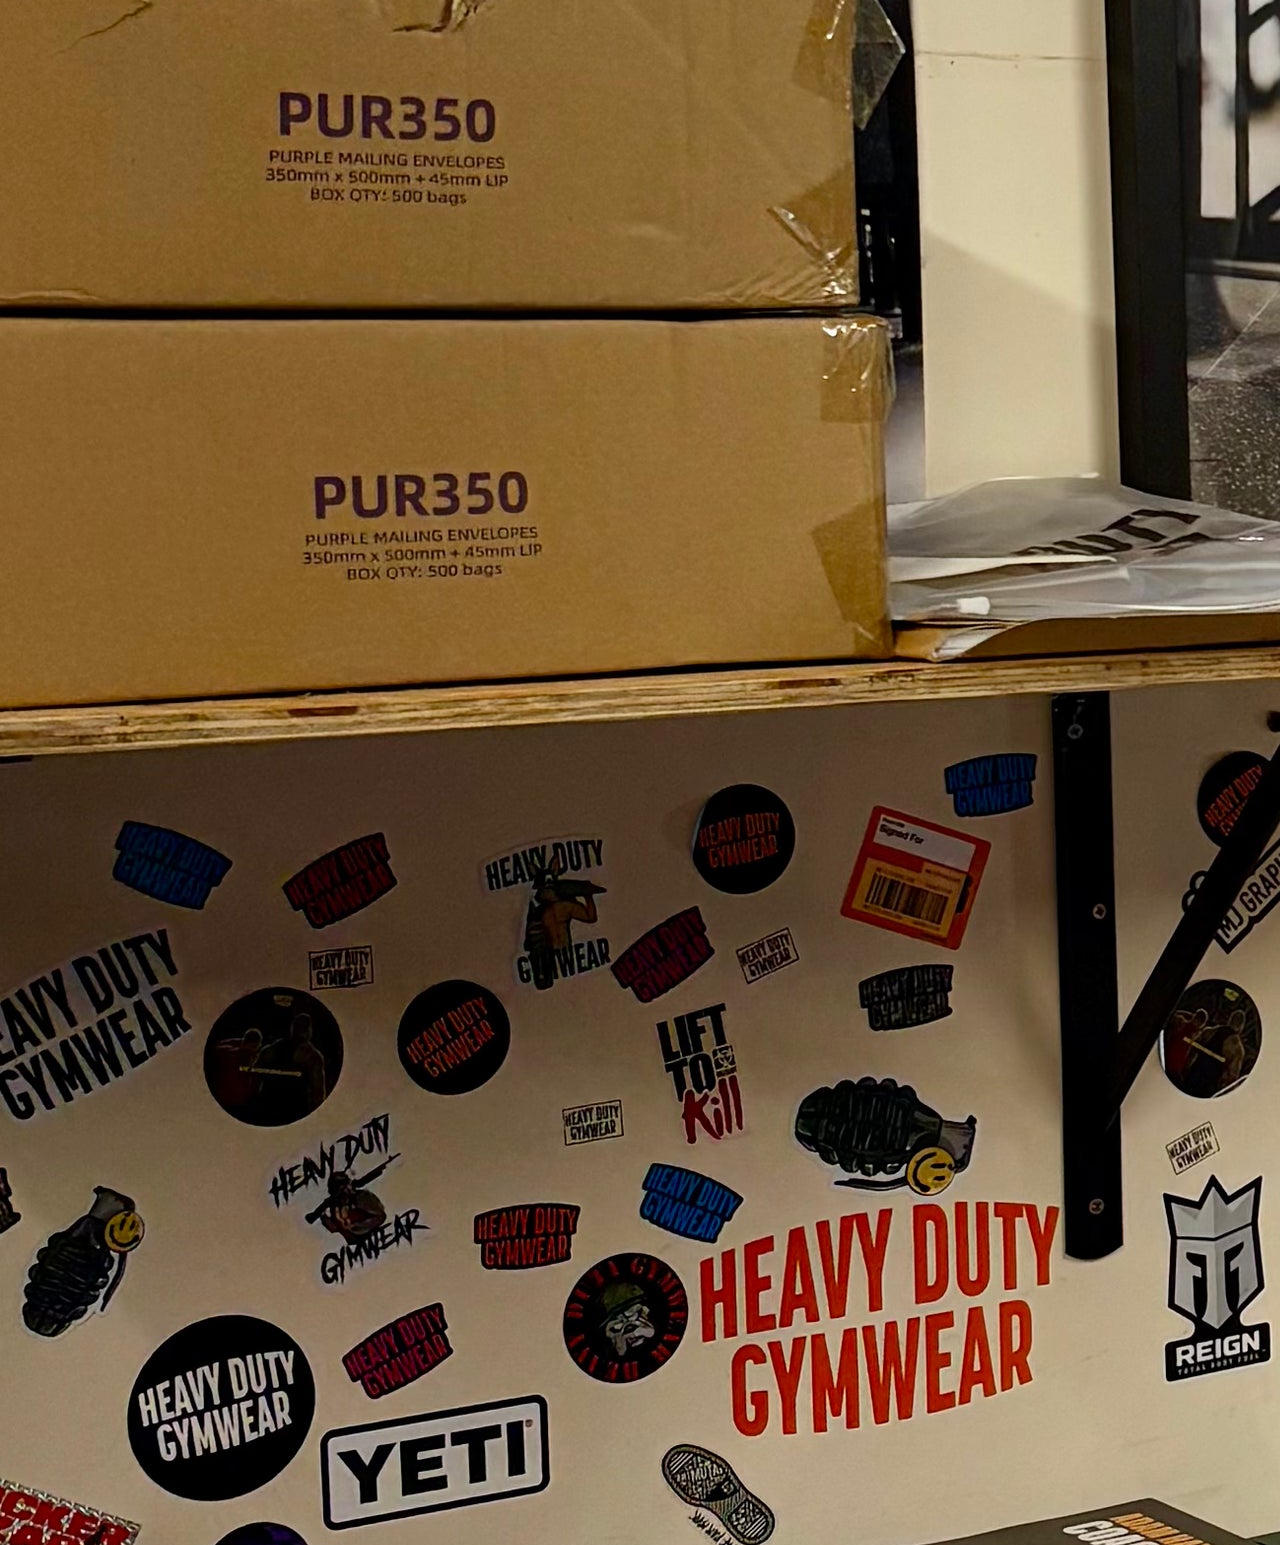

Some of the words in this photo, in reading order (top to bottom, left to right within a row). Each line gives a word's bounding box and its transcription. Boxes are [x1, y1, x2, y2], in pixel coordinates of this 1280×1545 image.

[279, 92, 496, 143] PUR350
[266, 168, 330, 182] 350mm
[348, 170, 411, 184] 500mm
[428, 173, 481, 187] 45mm
[269, 150, 333, 165] PURPLE
[338, 152, 408, 167] MAILING
[413, 154, 505, 169] ENVELOPES
[310, 187, 345, 201] BOX
[392, 189, 423, 203] 500
[427, 190, 468, 207] bags
[313, 471, 529, 519] PUR350
[303, 550, 365, 565] 350mm
[385, 548, 446, 562] 500mm
[465, 544, 516, 558] 45mm
[520, 543, 543, 556] LIP
[305, 532, 368, 547] PURPLE
[374, 530, 443, 544] MAILING
[448, 526, 538, 541] ENVELOPES
[347, 567, 381, 581] BOX
[386, 566, 423, 580] QTY:
[428, 564, 458, 577] 500
[462, 562, 503, 577] bags
[1204, 786, 1240, 829] HEAVY
[1238, 763, 1264, 798] DUTY
[699, 818, 741, 850] HEAVY
[743, 811, 781, 837] DUTY
[706, 833, 779, 869] GYMWEAR
[485, 847, 549, 891] HEAVY
[552, 839, 603, 876] DUTY
[1219, 910, 1246, 940] MJ
[516, 938, 612, 985] GWEAR
[0, 968, 79, 1066] AVY
[71, 928, 178, 1016] DUTY
[0, 986, 192, 1120] GYMWEAR
[405, 1014, 447, 1065] HEAVY
[446, 996, 490, 1037] DUTY
[422, 1019, 497, 1078] GYMWEAR
[657, 1003, 727, 1063] LIFT
[665, 1054, 716, 1103] TO
[563, 1108, 595, 1129] HEAVY
[595, 1104, 620, 1124] DUTY
[569, 1119, 618, 1141] GYMWEAR
[681, 1075, 743, 1144] Kill
[268, 1140, 335, 1208] HEAVY
[336, 1113, 391, 1172] DUTY
[642, 1191, 727, 1241] GYMWEAR
[645, 1164, 696, 1204] HEAVY
[696, 1181, 741, 1219] DUTY
[319, 1207, 431, 1285] GYMWEAR
[476, 1210, 531, 1241] HEAVY
[532, 1206, 580, 1235] DUTY
[482, 1234, 572, 1269] GYMWEAR
[698, 1207, 893, 1343] HEAVY
[911, 1201, 1061, 1305] DUTY
[345, 1329, 397, 1381] HEAVY
[396, 1306, 448, 1345] DUTY
[361, 1334, 453, 1398] GYMWEAR
[730, 1300, 1033, 1437] GYMWEAR
[1175, 1329, 1261, 1367] REIGN
[137, 1360, 222, 1428] HEAVY
[226, 1349, 297, 1403] DUTY
[156, 1388, 293, 1463] GYMWEAR
[336, 1418, 526, 1506] YETI
